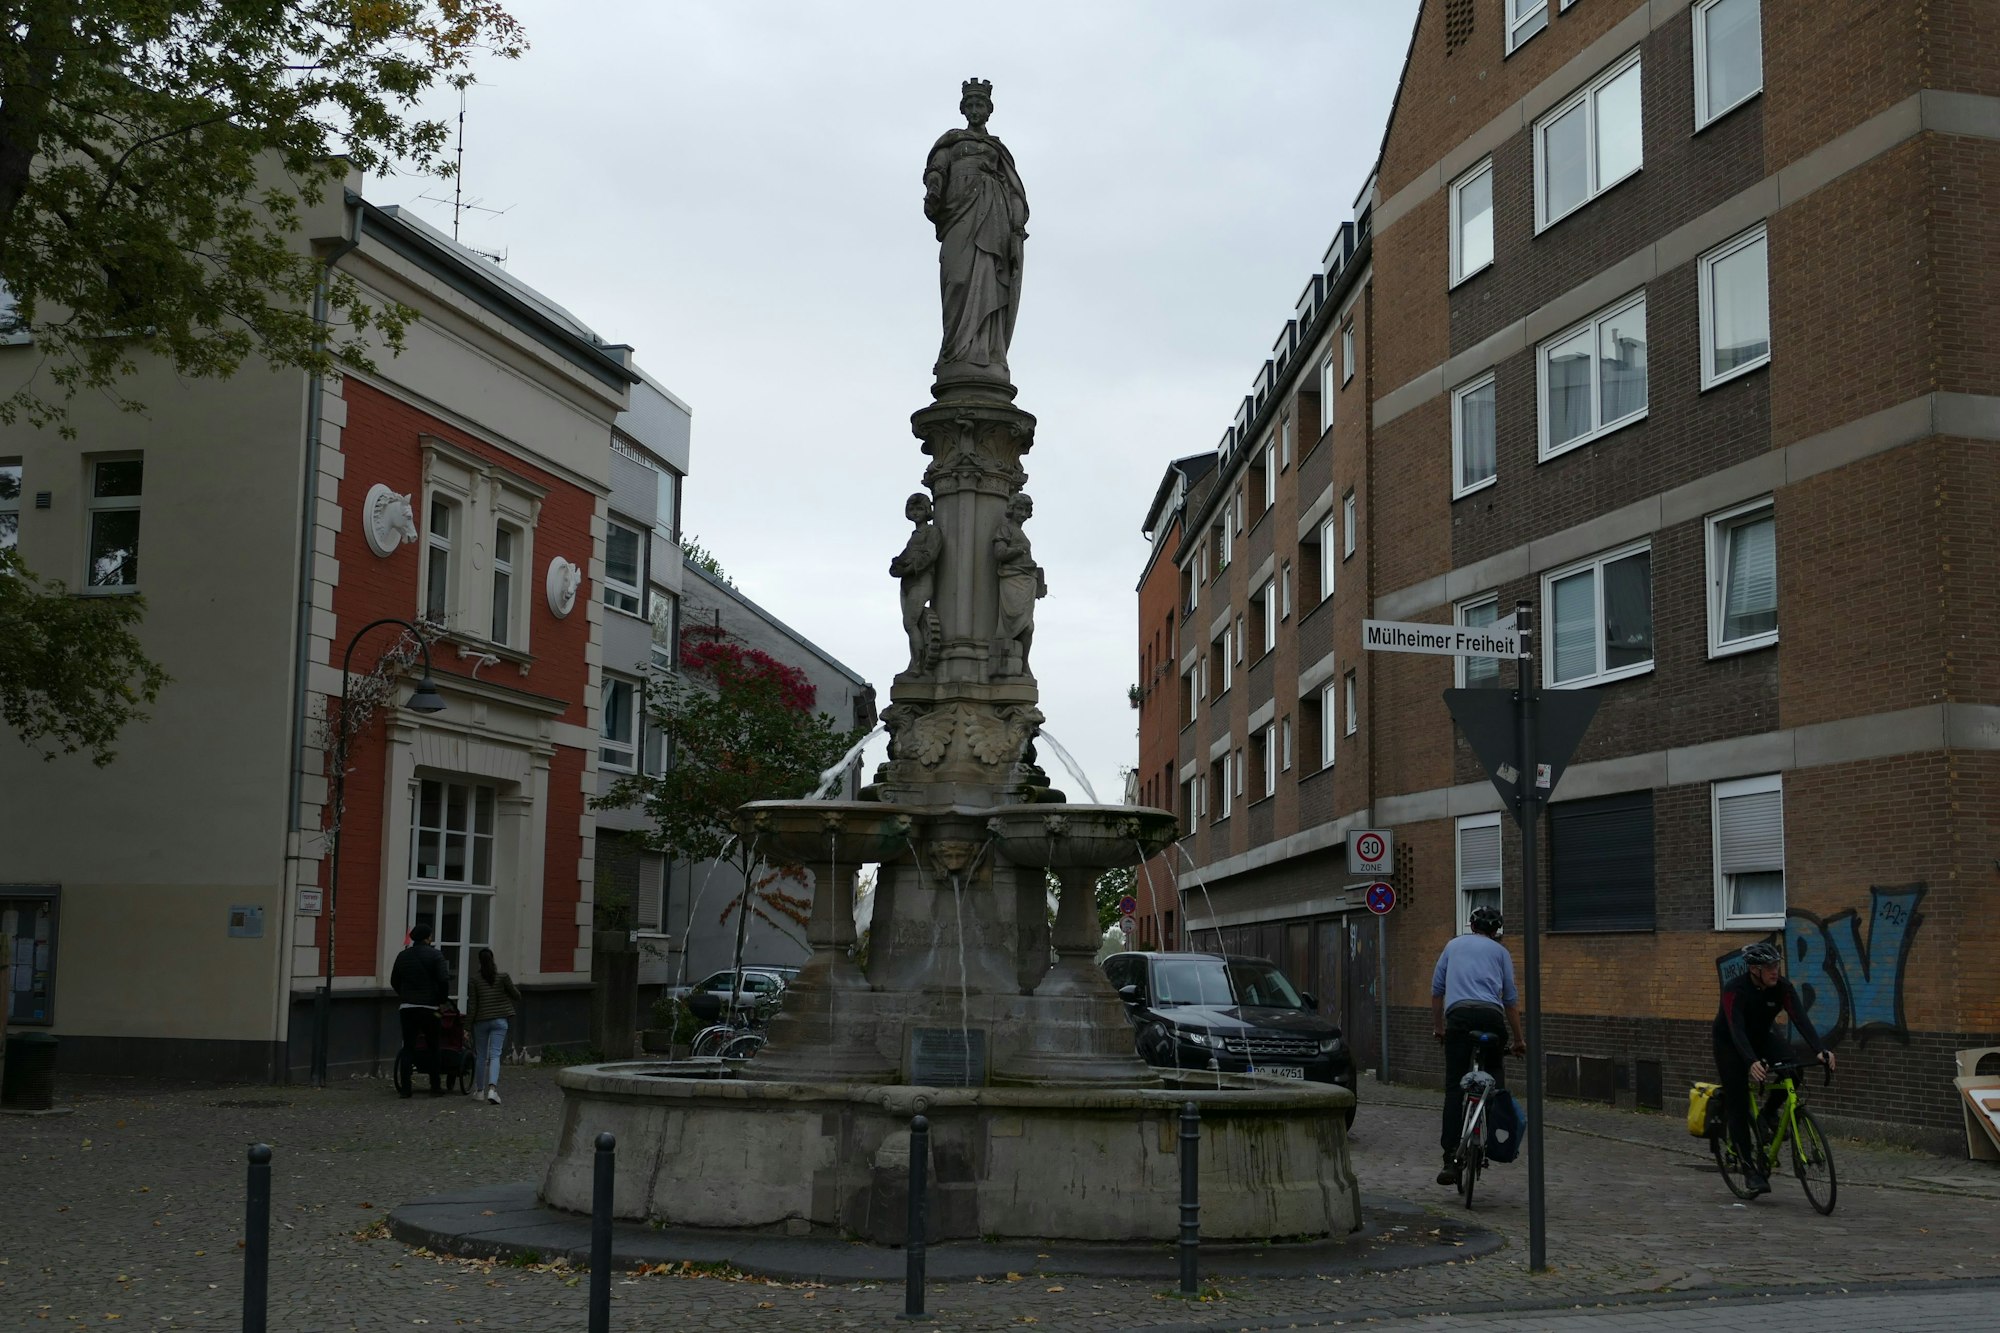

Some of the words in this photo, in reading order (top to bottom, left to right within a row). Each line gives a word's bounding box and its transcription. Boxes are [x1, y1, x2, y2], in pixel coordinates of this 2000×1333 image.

[1368, 626, 1451, 649] Mülheimer
[1456, 633, 1514, 654] Freiheit
[1362, 841, 1379, 855] 30
[1360, 863, 1382, 872] ZONE
